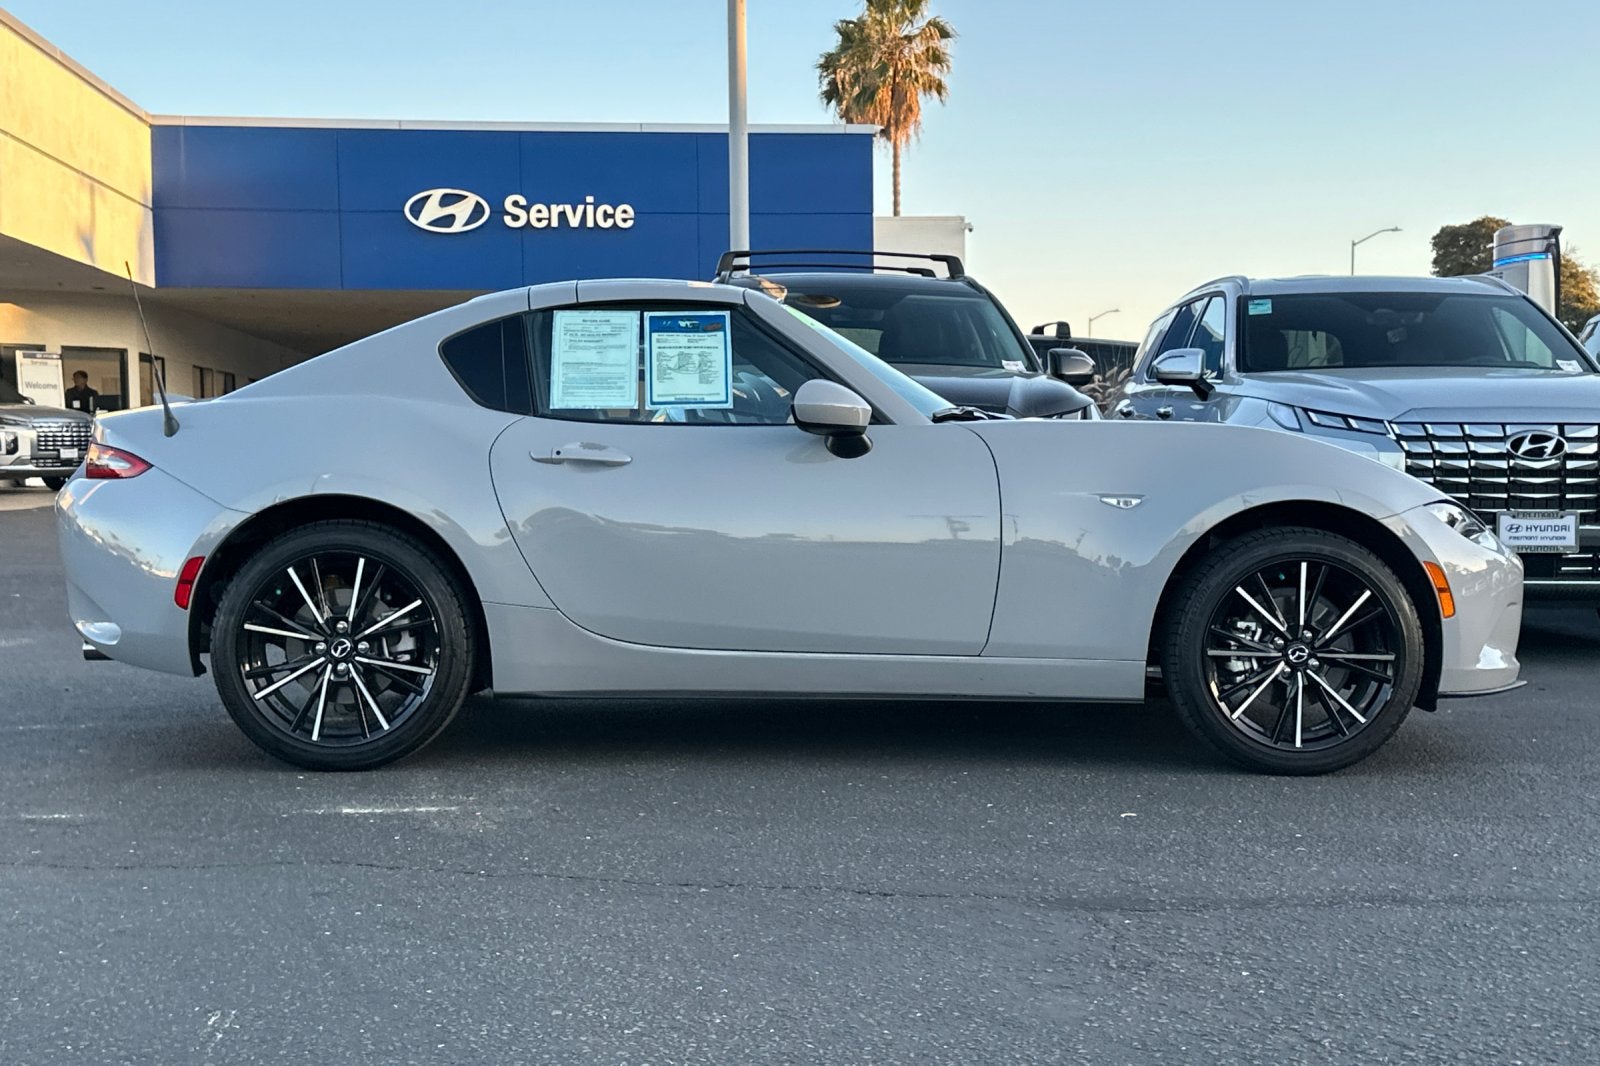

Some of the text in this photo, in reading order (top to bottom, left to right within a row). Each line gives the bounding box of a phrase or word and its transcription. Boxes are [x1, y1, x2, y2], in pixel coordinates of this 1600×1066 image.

[503, 194, 635, 229] Service
[25, 381, 58, 390] Welcome
[1525, 524, 1571, 533] HYUNDAI
